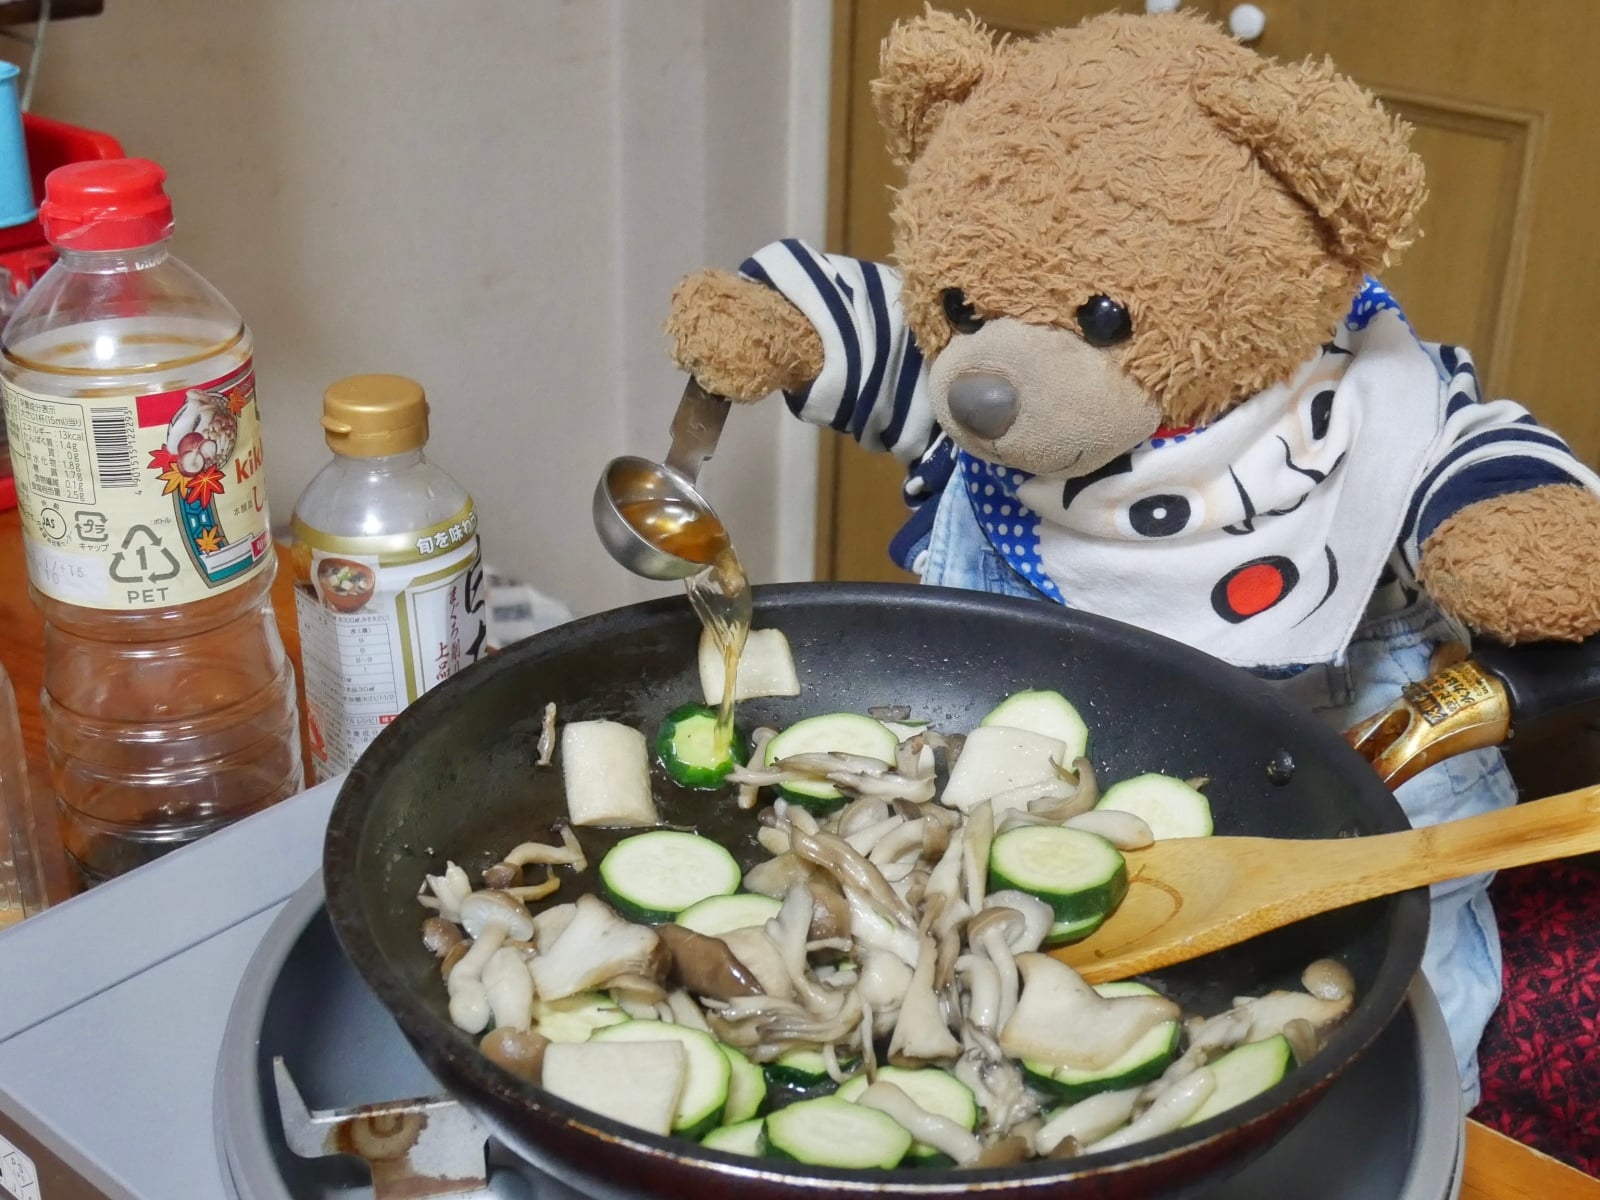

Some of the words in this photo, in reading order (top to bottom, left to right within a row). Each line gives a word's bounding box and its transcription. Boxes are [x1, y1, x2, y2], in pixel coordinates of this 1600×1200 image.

[59, 430, 84, 442] 13kcal
[42, 516, 56, 529] JAS
[83, 519, 105, 534] プラ
[79, 542, 110, 552] キャップ
[136, 546, 147, 570] 1
[127, 587, 169, 604] PET
